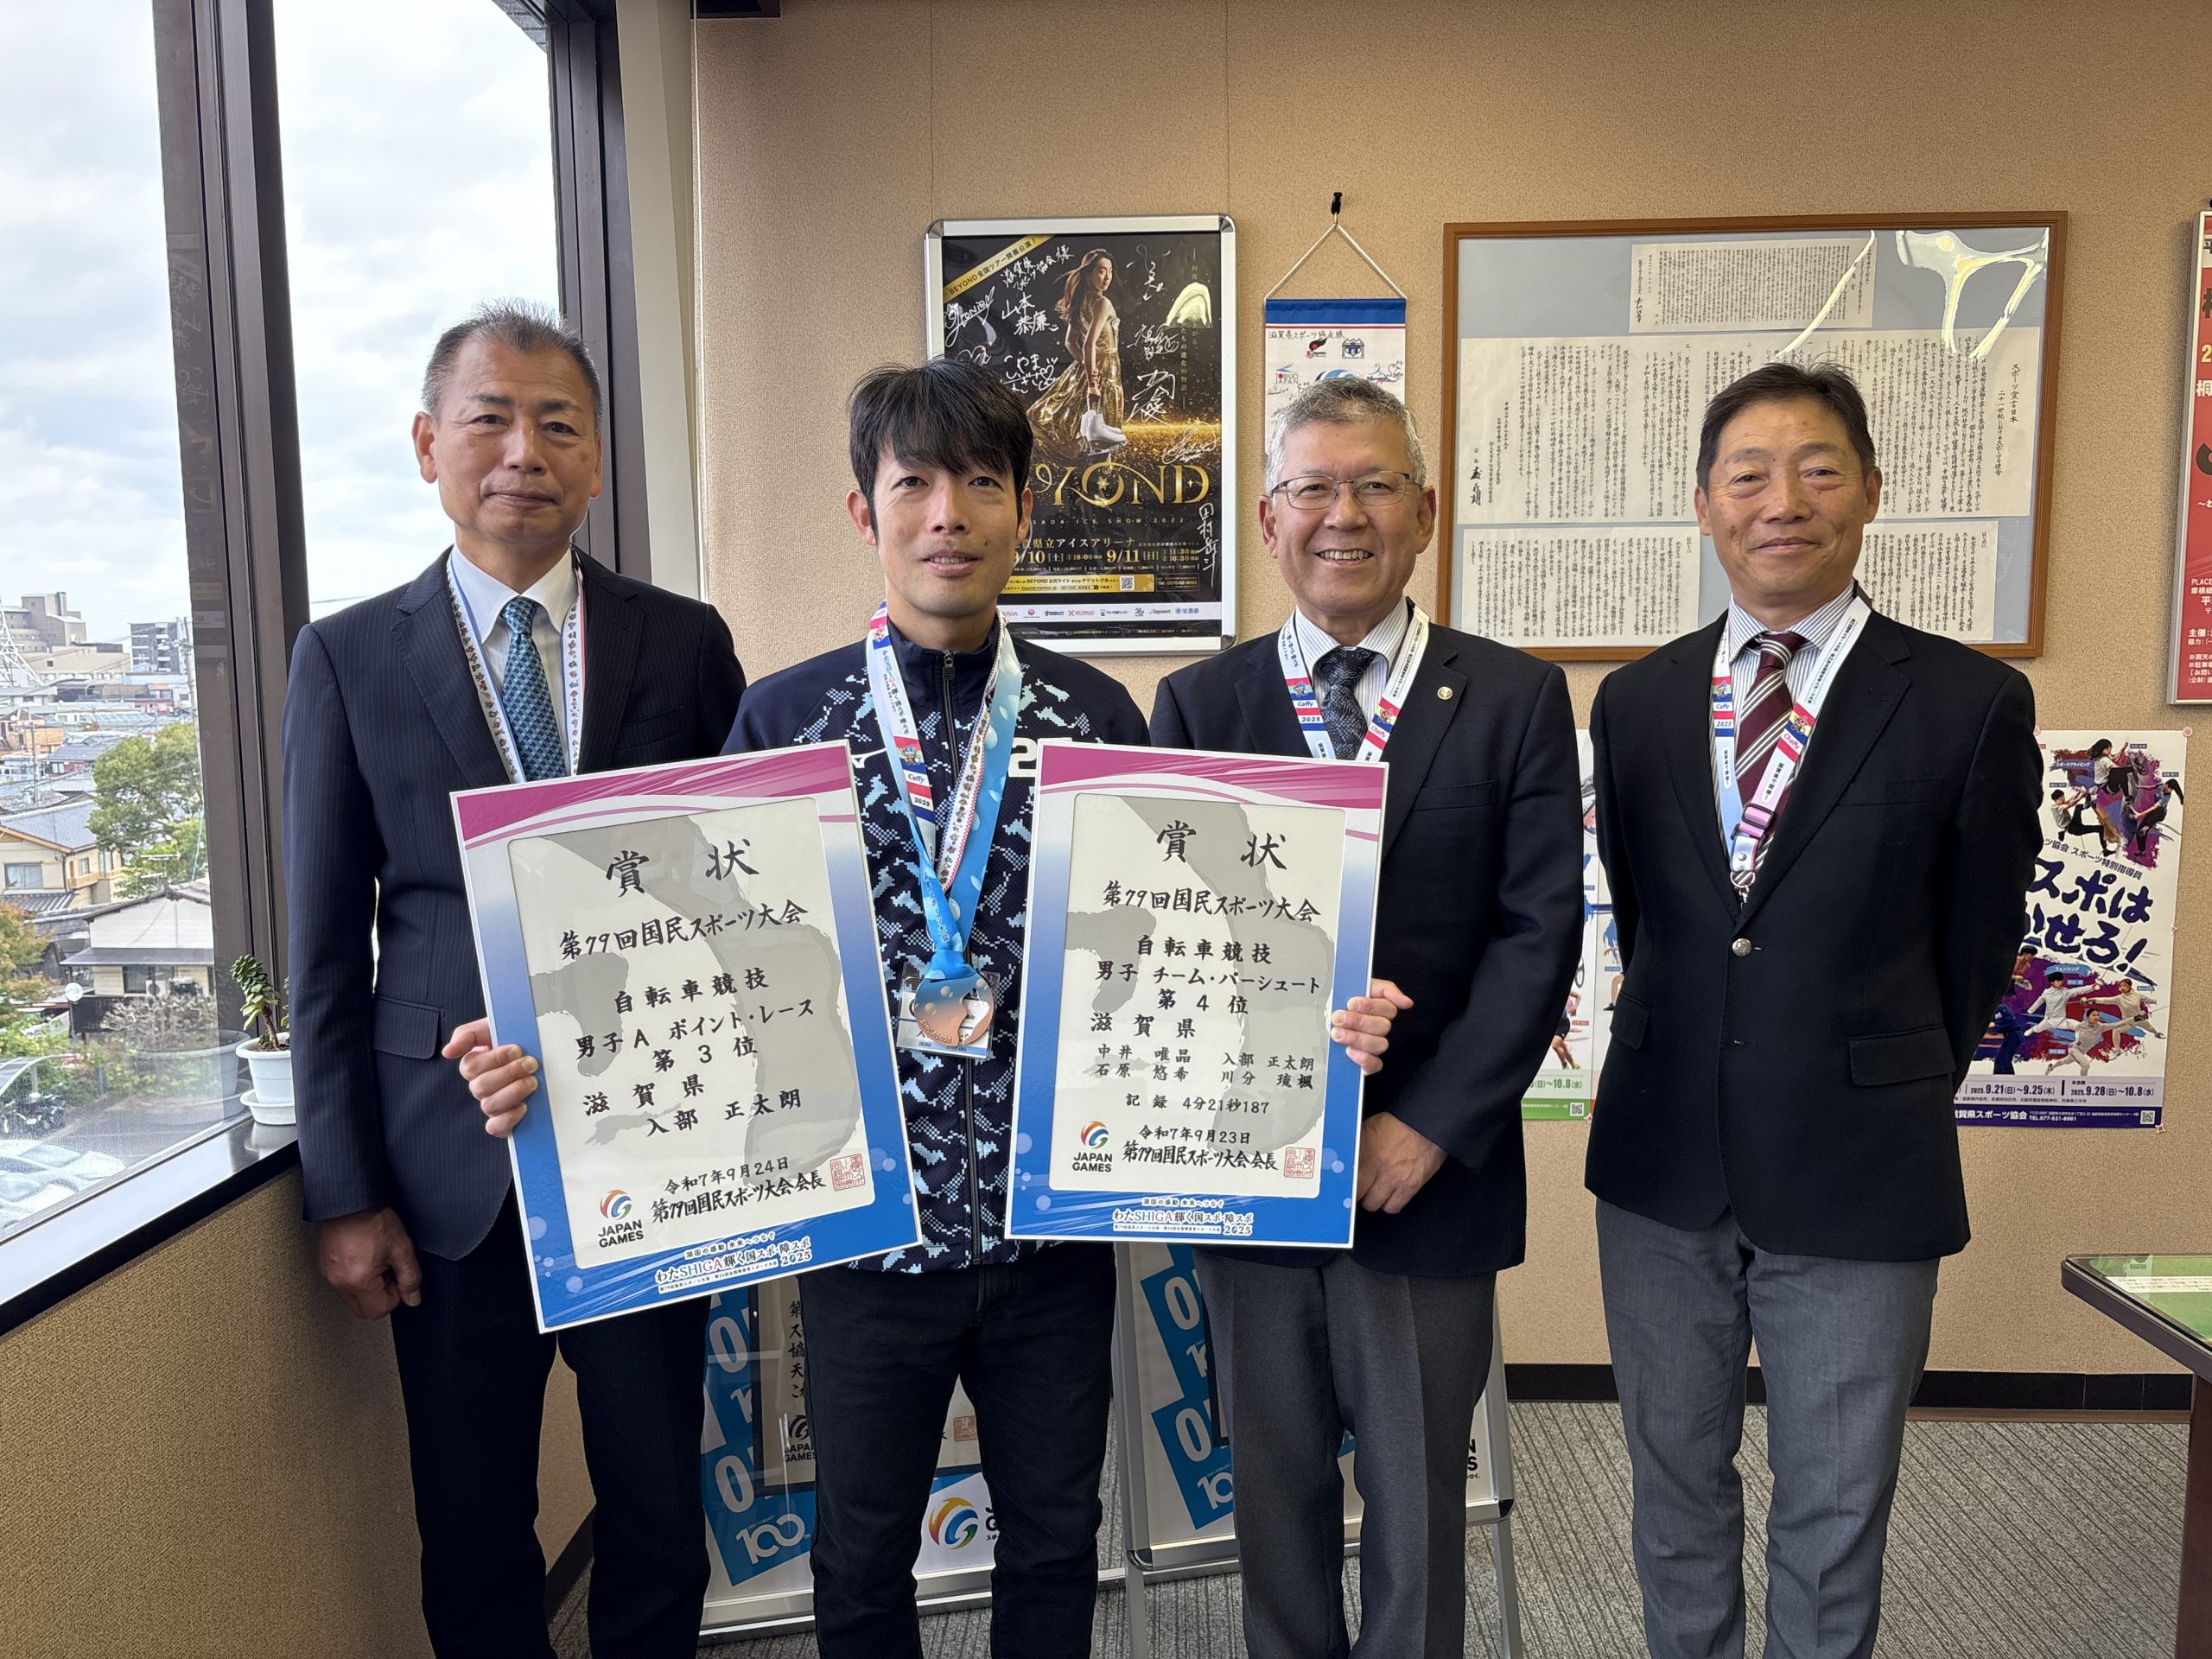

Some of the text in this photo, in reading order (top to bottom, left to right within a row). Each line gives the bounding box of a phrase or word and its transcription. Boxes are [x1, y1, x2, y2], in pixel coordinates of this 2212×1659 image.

[2009, 363, 2020, 424] スポーツ宣言日本
[1030, 461, 1210, 508] YOND
[1297, 700, 1314, 709] Caffy
[1370, 725, 1387, 739] Chaffy
[1783, 733, 1801, 750] Chaffy
[907, 772, 925, 785] Caffy
[913, 797, 931, 807] 2025
[1156, 819, 1287, 870] 賞状
[605, 837, 760, 898] 賞状
[2044, 838, 2143, 880] ツ協会 スポーツ特別指導員
[1102, 879, 1321, 924] 第79回国民スポーツ大会
[558, 899, 809, 960] 第79回国民スポーツ大会
[1135, 934, 1273, 966] 自転車競技
[613, 968, 770, 1014] 自転車競技
[1093, 959, 1321, 995] 男子 チーム・パーシュート
[1156, 988, 1249, 1016] 第4位
[669, 999, 815, 1039] ポイント・レース
[1090, 1012, 1196, 1039] 滋賀県
[652, 1035, 759, 1072] 第3位
[582, 1074, 704, 1116] 滋賀県
[1182, 1096, 1270, 1115] 4分21秒187
[1138, 1124, 1252, 1147] 令和7年9月23日
[1071, 1160, 1112, 1173] GAMES
[1072, 1152, 1113, 1164] JAPAN
[664, 1156, 790, 1194] 令和7年9月24日
[598, 1219, 643, 1237] JAPAN
[599, 1228, 645, 1249] GAMES
[1224, 1225, 1252, 1235] 2025
[781, 1251, 811, 1266] 2025
